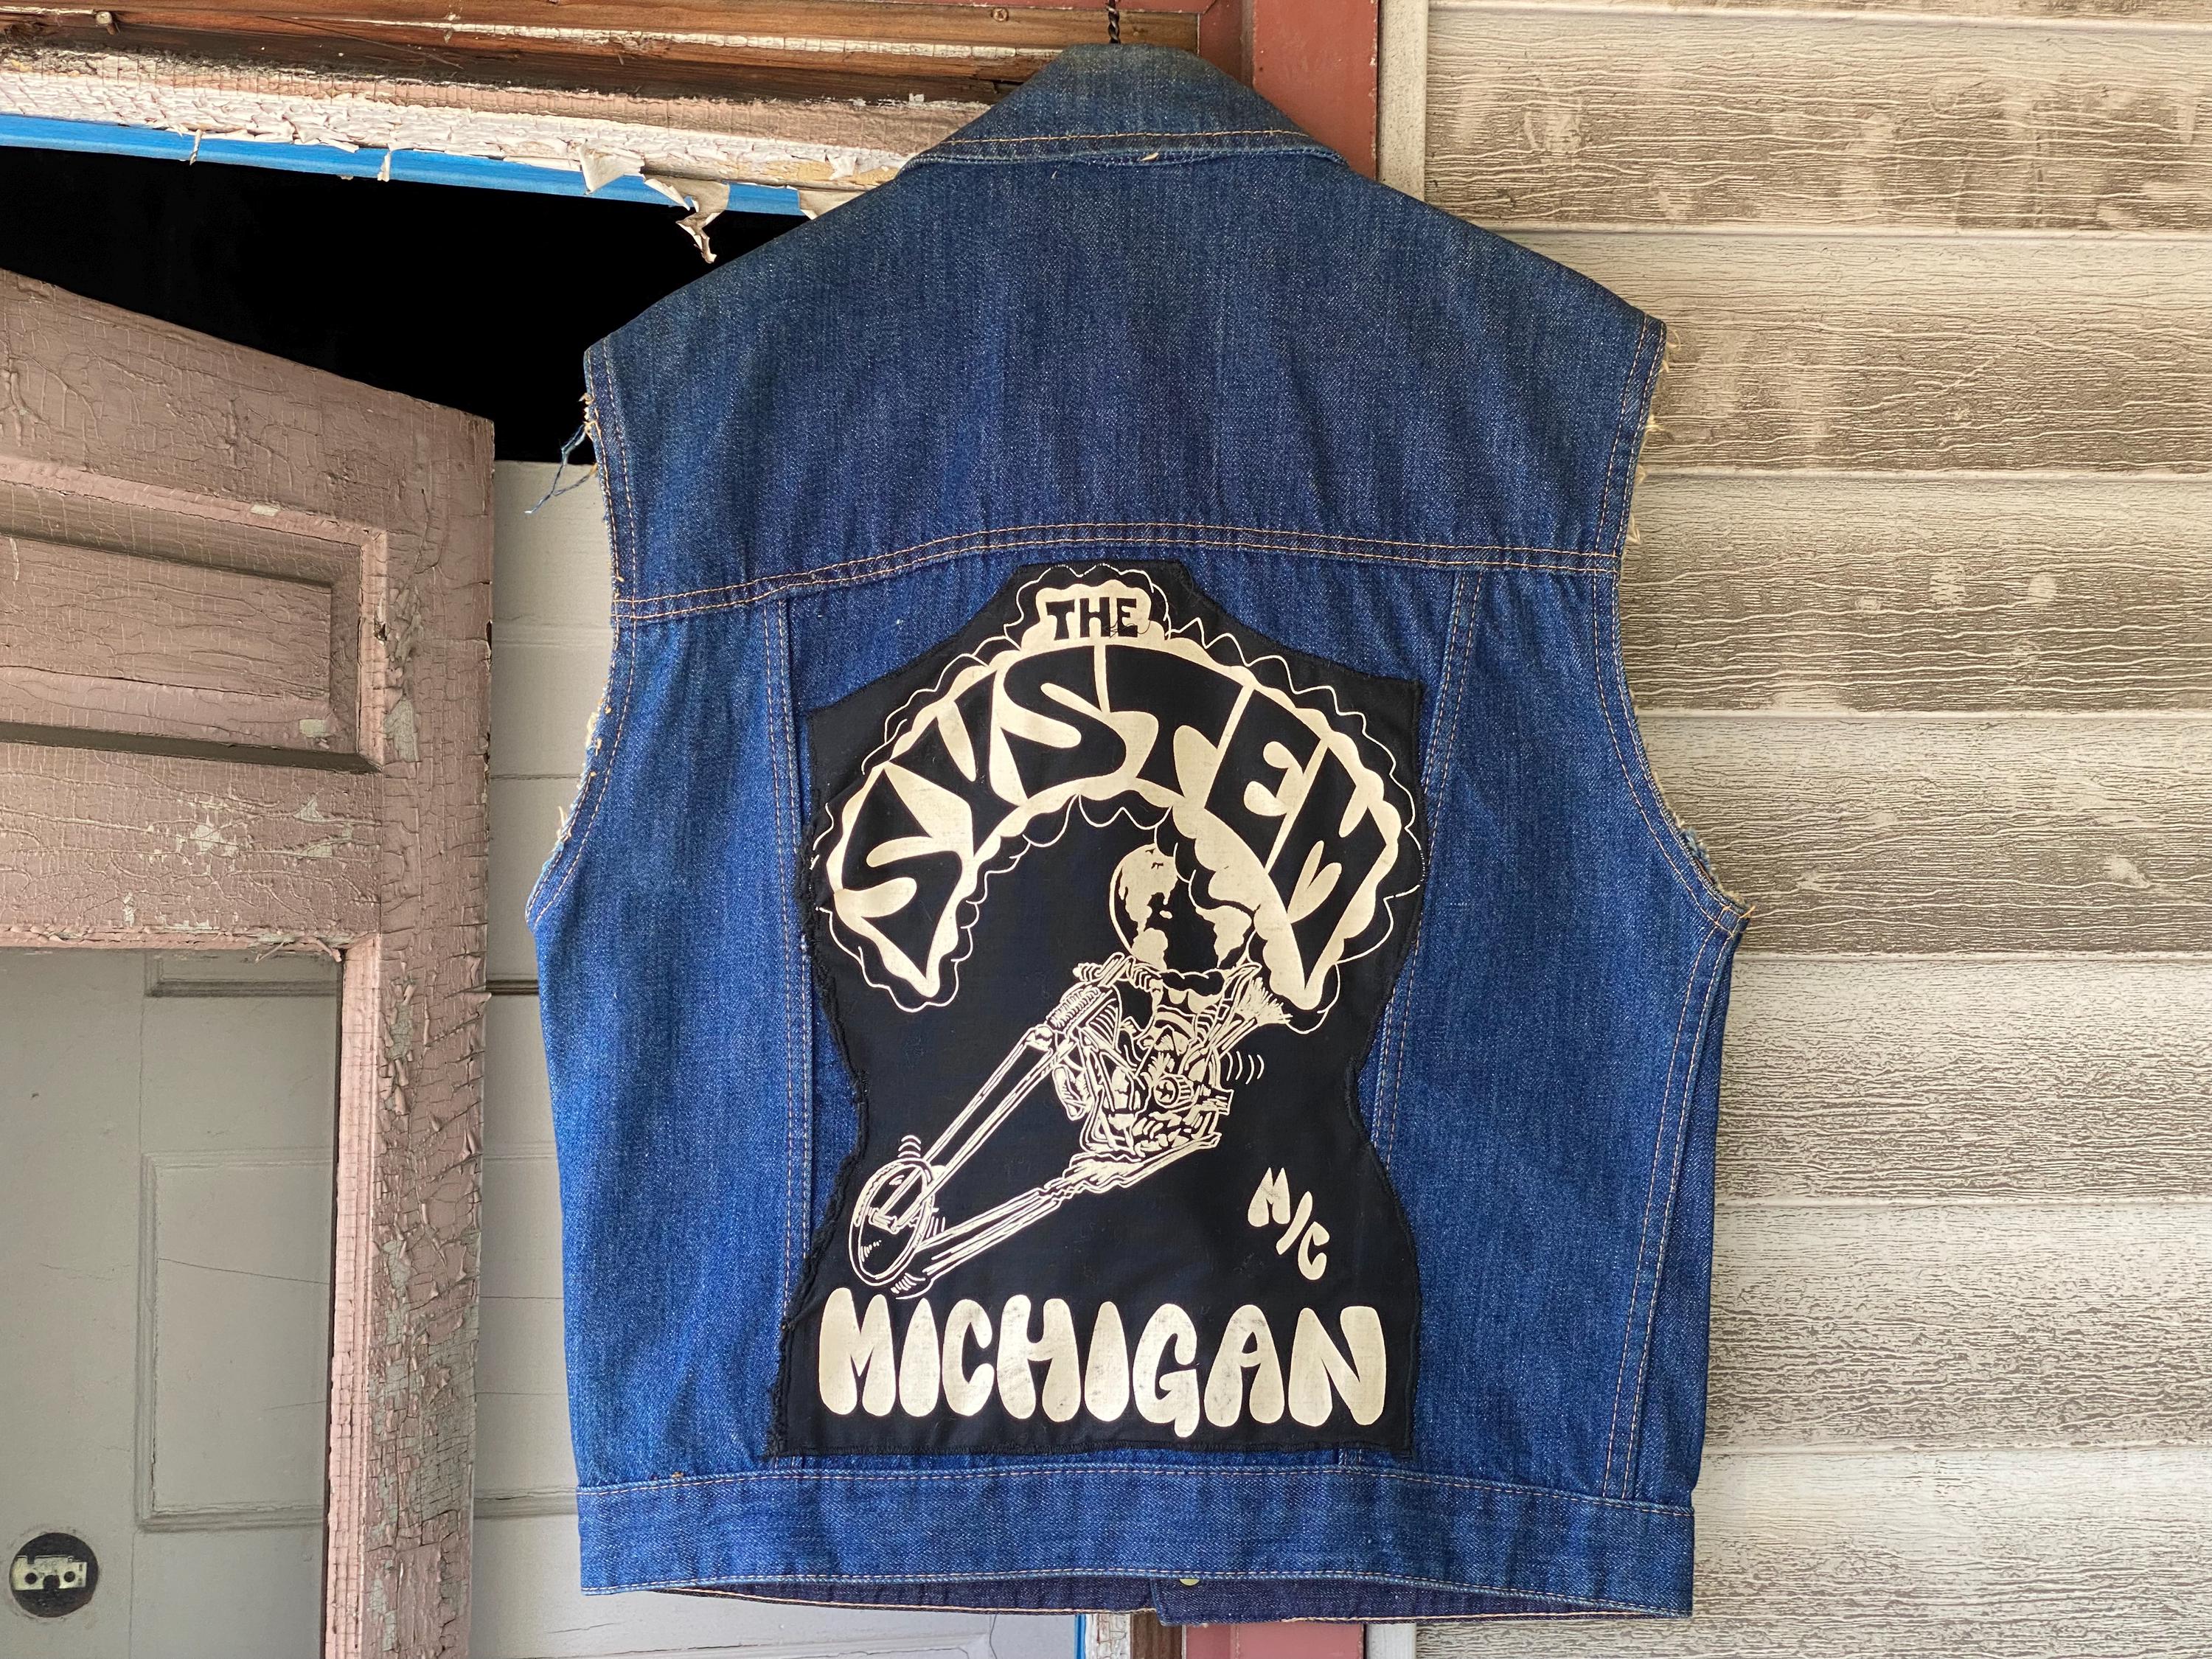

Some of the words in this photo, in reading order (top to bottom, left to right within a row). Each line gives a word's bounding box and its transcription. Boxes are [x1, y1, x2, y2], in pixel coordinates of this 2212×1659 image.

[1047, 597, 1141, 639] THE
[841, 644, 1387, 991] SYSTEM
[1248, 1167, 1329, 1281] M/C
[818, 1287, 1386, 1438] MICHIGAN
